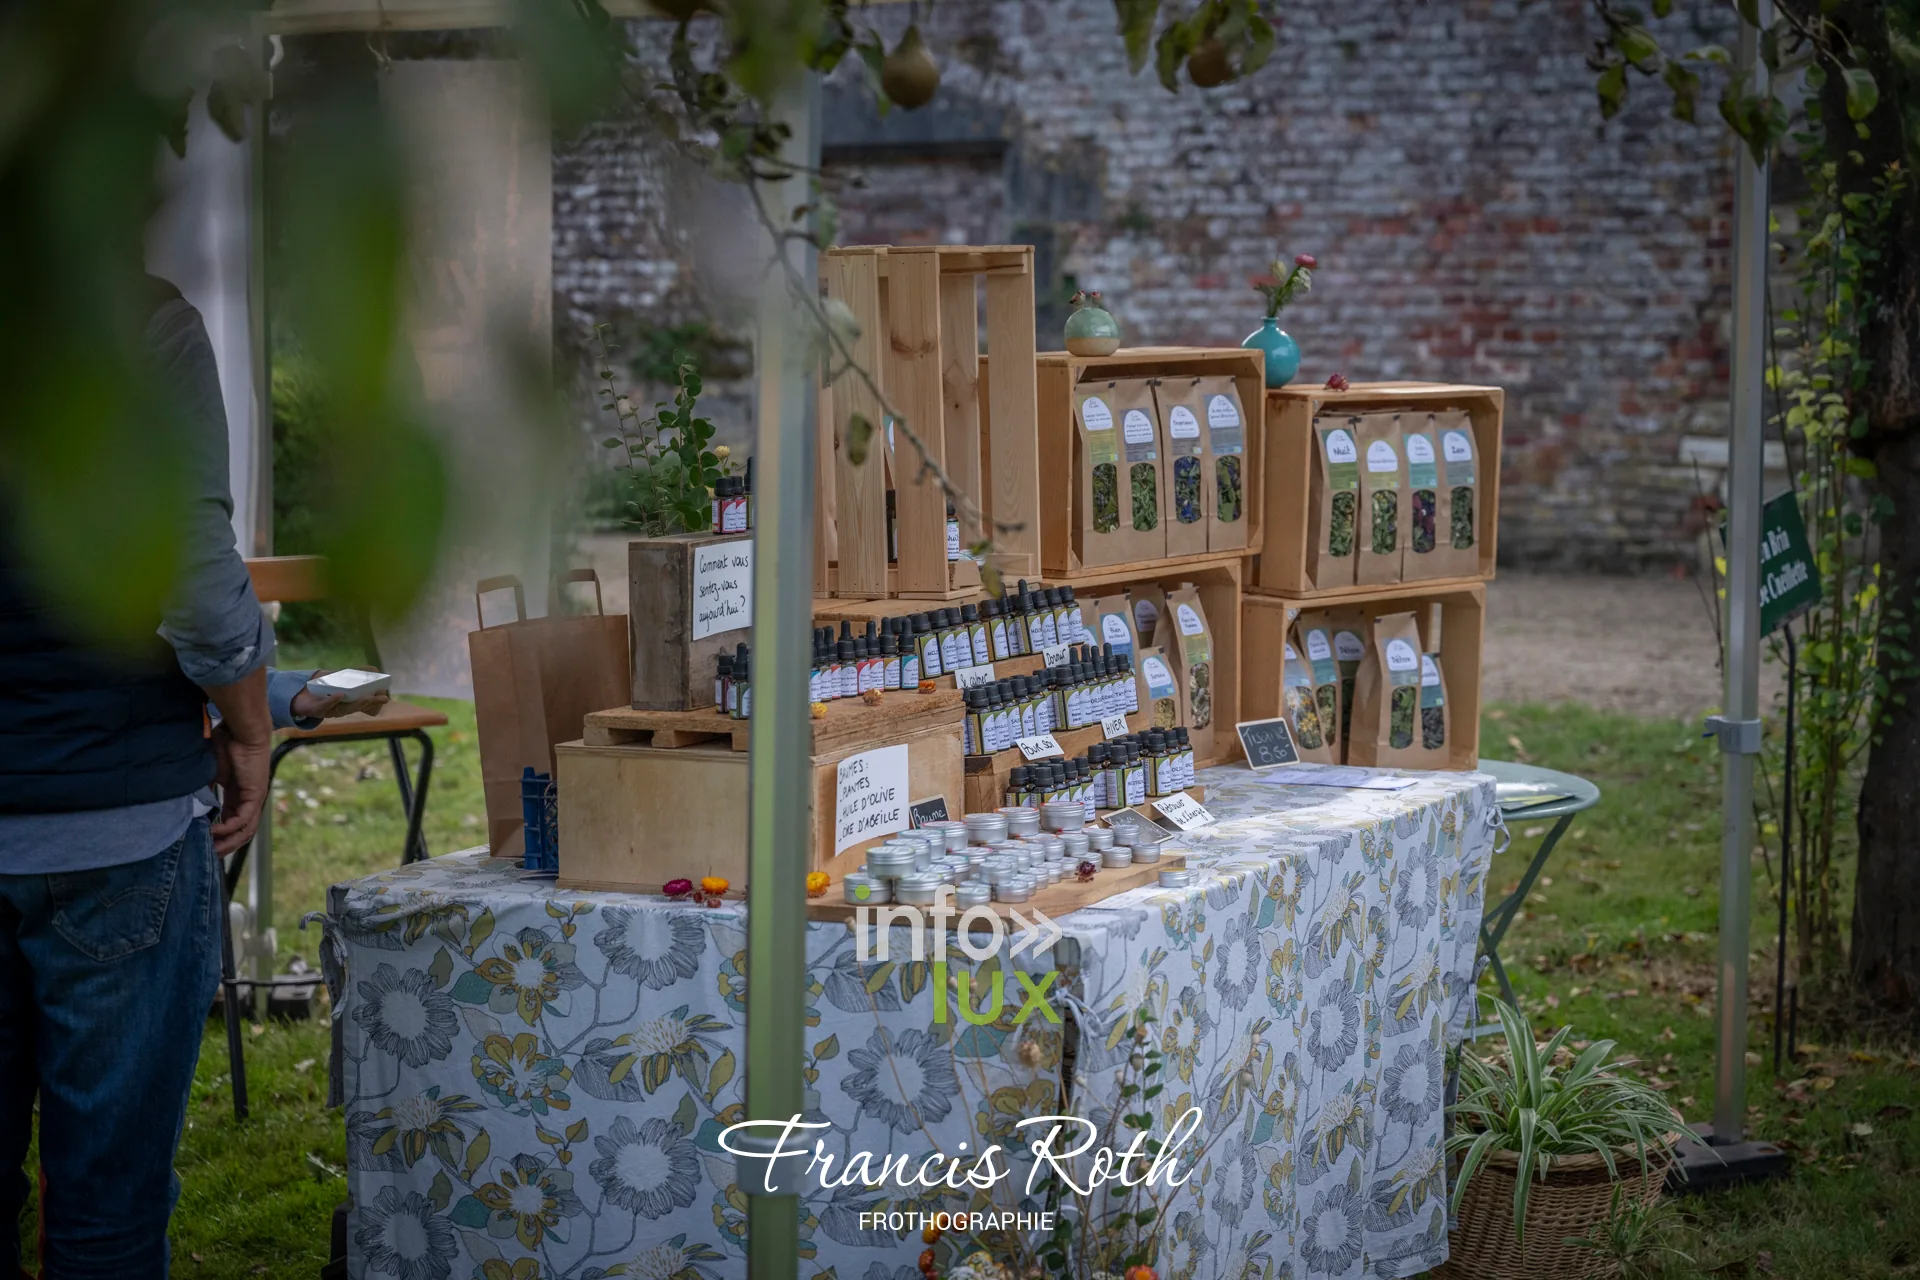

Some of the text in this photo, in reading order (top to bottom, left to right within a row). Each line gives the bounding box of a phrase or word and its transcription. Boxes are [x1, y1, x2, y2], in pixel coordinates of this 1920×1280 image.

[1333, 445, 1351, 455] Nuit
[699, 554, 749, 574] Comment vous
[699, 580, 738, 602] sentez-vous
[699, 599, 739, 632] aujourd'hui
[1105, 718, 1126, 735] HIVER
[1243, 727, 1288, 747] Tisane
[1020, 742, 1044, 757] POUR
[842, 786, 895, 819] HUILE D'OLIVE
[858, 808, 900, 833] D'ABEILLE
[913, 808, 946, 826] Baume
